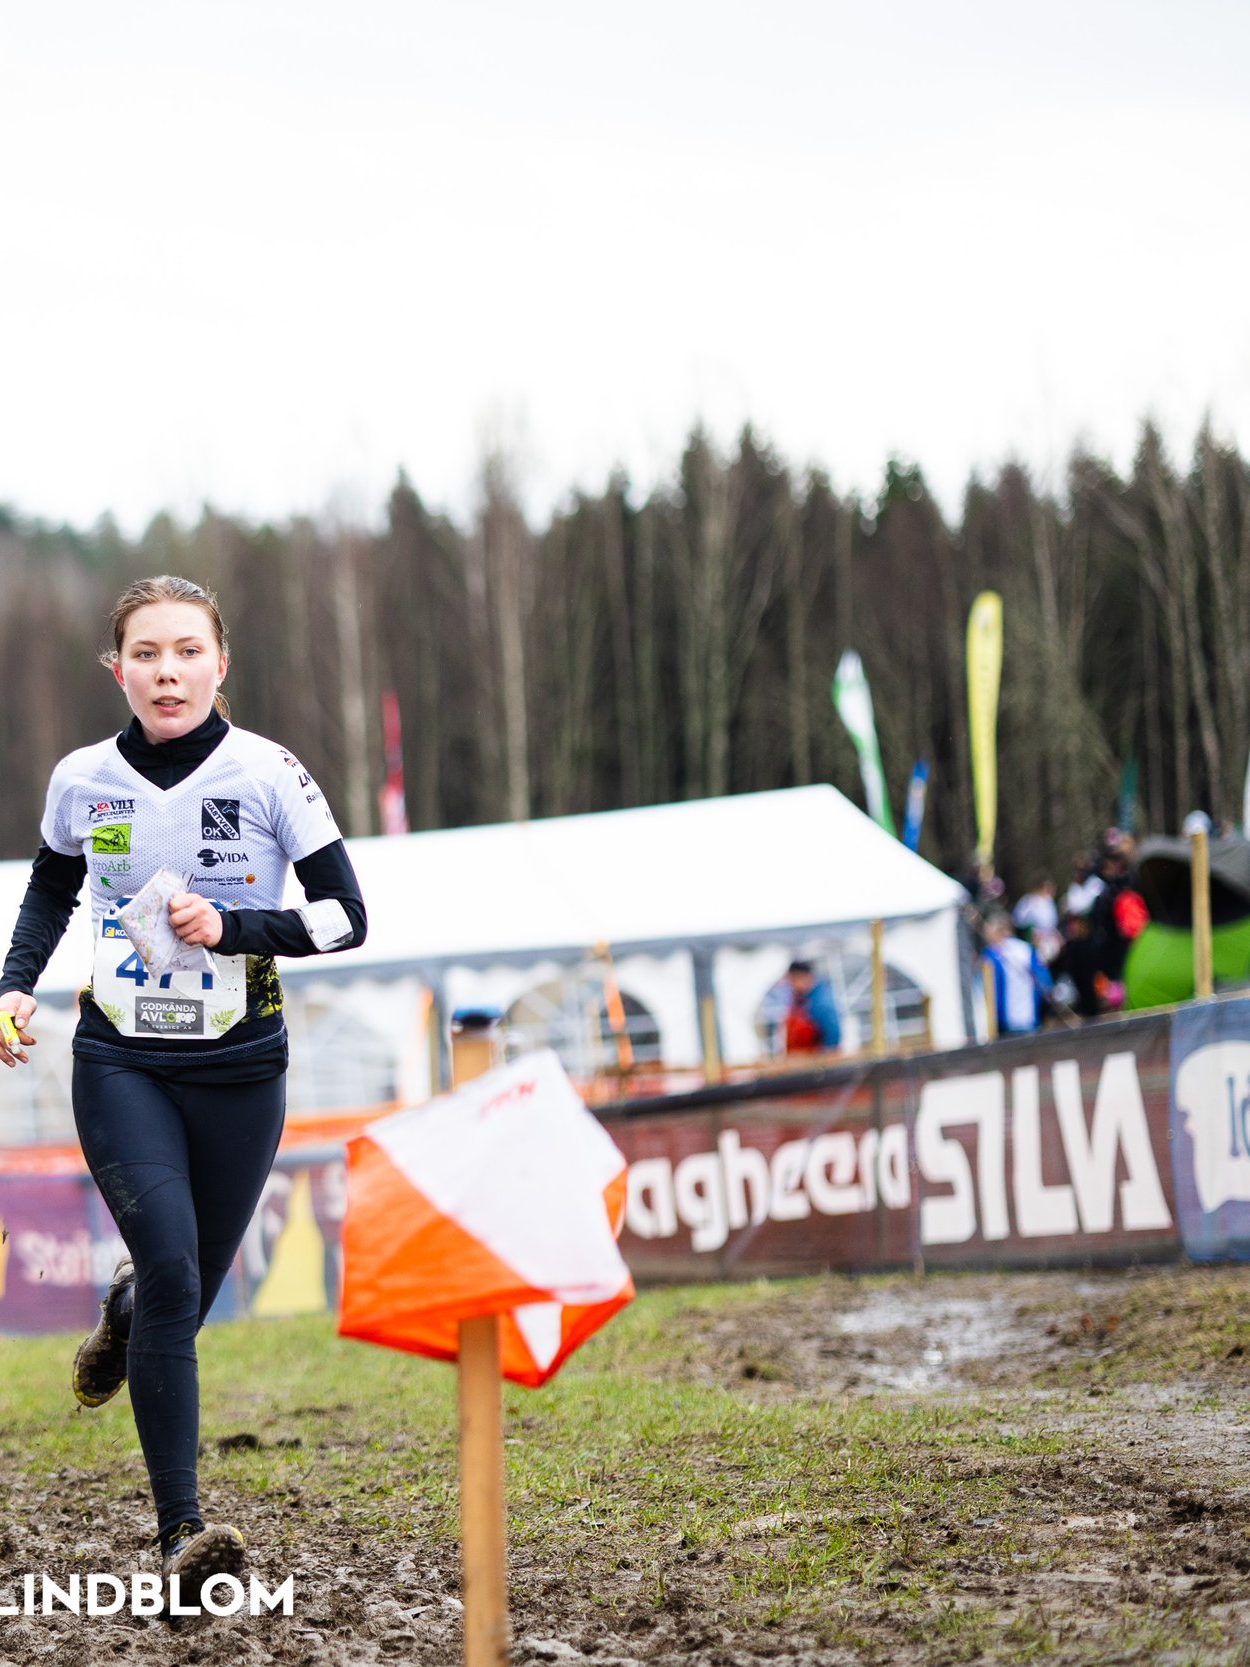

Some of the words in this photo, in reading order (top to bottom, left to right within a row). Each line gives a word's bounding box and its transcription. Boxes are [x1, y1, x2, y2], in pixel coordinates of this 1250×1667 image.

[110, 799, 135, 810] VILT
[203, 827, 222, 837] OK
[217, 852, 250, 862] VIDA
[140, 1002, 197, 1013] GODKÄNDA
[626, 1123, 911, 1253] agheera
[915, 1051, 1173, 1246] SILVA
